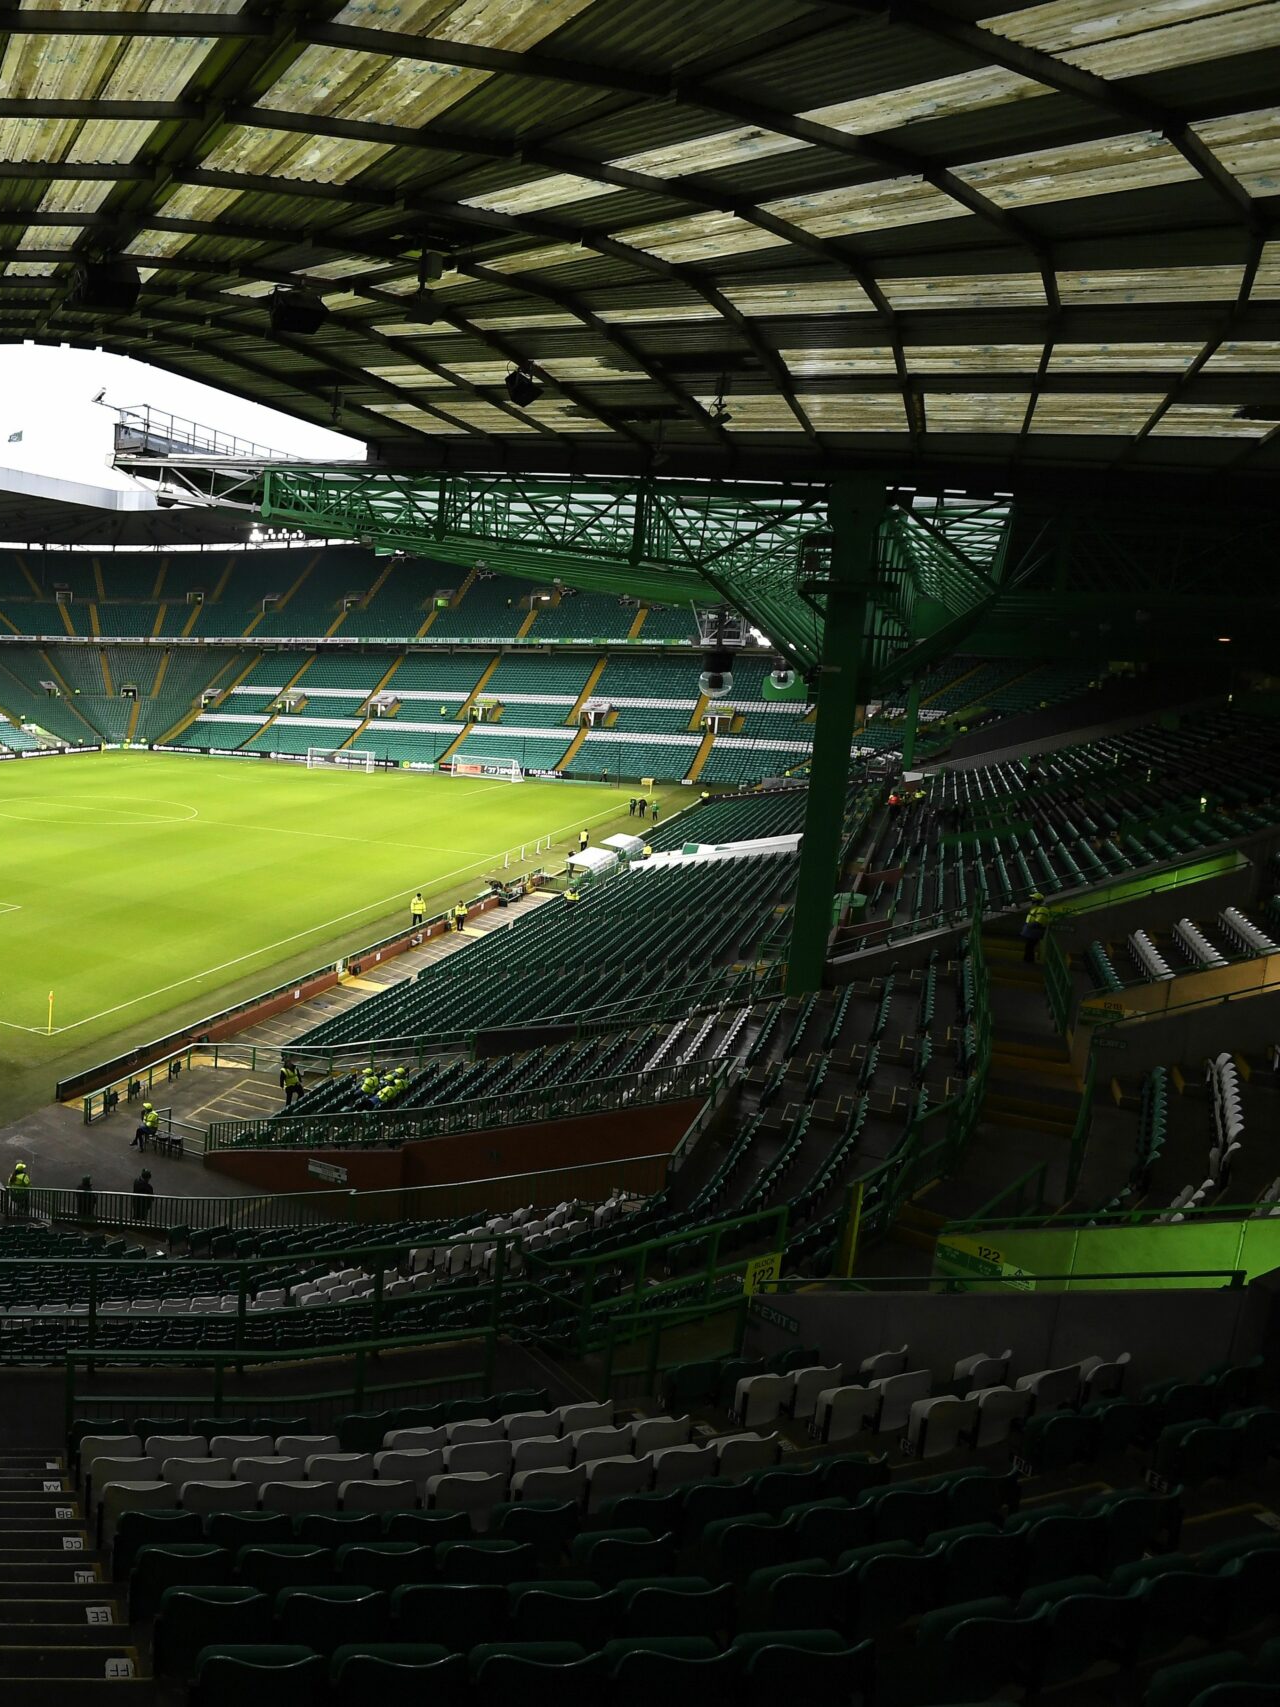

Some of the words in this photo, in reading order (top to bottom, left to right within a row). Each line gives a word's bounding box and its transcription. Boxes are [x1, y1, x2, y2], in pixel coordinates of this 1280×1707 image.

[977, 1246, 1001, 1263] 122
[752, 1267, 774, 1286] 122
[761, 1307, 789, 1326] EXIT
[65, 1540, 82, 1549] CC
[91, 1611, 109, 1622] EE
[109, 1663, 129, 1677] FF
